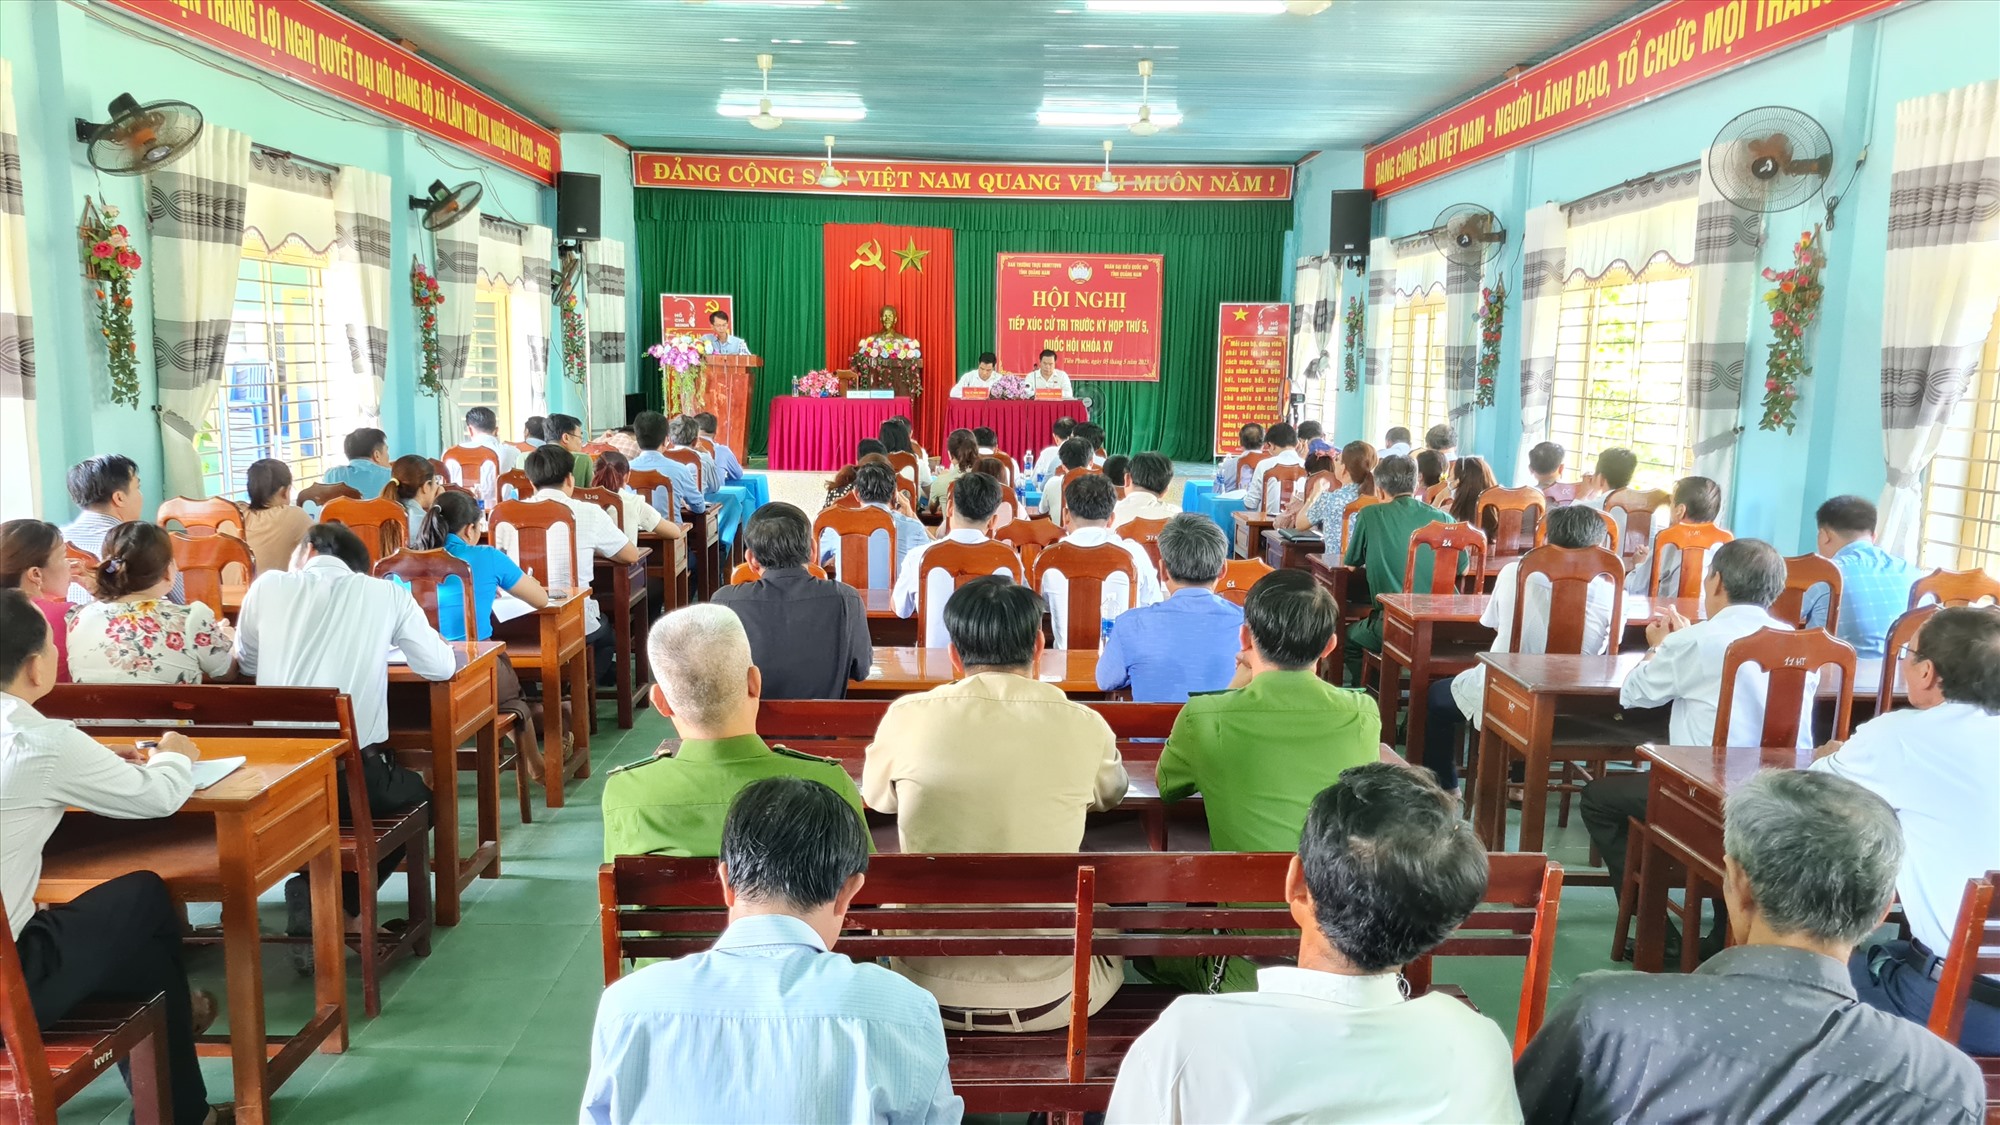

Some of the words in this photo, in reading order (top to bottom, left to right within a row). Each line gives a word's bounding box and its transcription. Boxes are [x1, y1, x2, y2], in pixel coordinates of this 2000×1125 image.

[259, 3, 282, 57] LỢI
[284, 15, 316, 75] NGHỊ
[318, 34, 353, 82] QUYẾT
[356, 50, 374, 97] ĐẠI
[376, 57, 394, 106] HỘI
[395, 62, 420, 111] ĐẢNG
[421, 79, 434, 124] BỘ
[434, 86, 447, 123] XÃ
[447, 88, 463, 131] LẦN
[463, 103, 478, 138] THỨ
[491, 118, 511, 156] NHIỆM
[511, 125, 520, 157] KỲ
[520, 133, 534, 164] 2020
[1375, 153, 1395, 187] ĐẢNG
[1396, 145, 1418, 182] CỘNG
[1418, 130, 1437, 168] SẢN
[1439, 124, 1459, 163] VIỆT
[1460, 115, 1485, 152] NAM
[1487, 125, 1492, 133] -
[1494, 88, 1533, 138] NGƯỜI
[1534, 78, 1572, 122] LÃNH
[1575, 60, 1611, 109] ĐẠO,
[1617, 28, 1642, 89] TỔ
[1642, 17, 1697, 79] CHỨC
[1701, 0, 1748, 55] MỌI
[653, 156, 722, 183] ĐẢNG
[727, 162, 794, 188] CỘNG
[856, 166, 912, 192] VIỆT
[919, 171, 970, 190] NAM
[978, 172, 1061, 193] QUANG
[1132, 170, 1203, 193] MUÔN
[1208, 171, 1262, 192] NĂM
[1269, 175, 1275, 192] !
[1032, 286, 1070, 312] HỘI
[1075, 290, 1127, 313] NGHỊ
[1008, 314, 1025, 331] TIẾP
[1027, 315, 1042, 331] XÚC
[1044, 314, 1056, 331] CỬ
[1057, 318, 1069, 332] TRI
[1070, 317, 1095, 332] TRƯỚC
[1108, 320, 1124, 335] HỌP
[1125, 317, 1142, 333] THỨ
[1141, 320, 1149, 335] 5,
[1043, 335, 1064, 352] QUỐC
[1066, 337, 1079, 355] HỘI
[1081, 338, 1101, 353] KHÓA
[1103, 340, 1114, 353] XV
